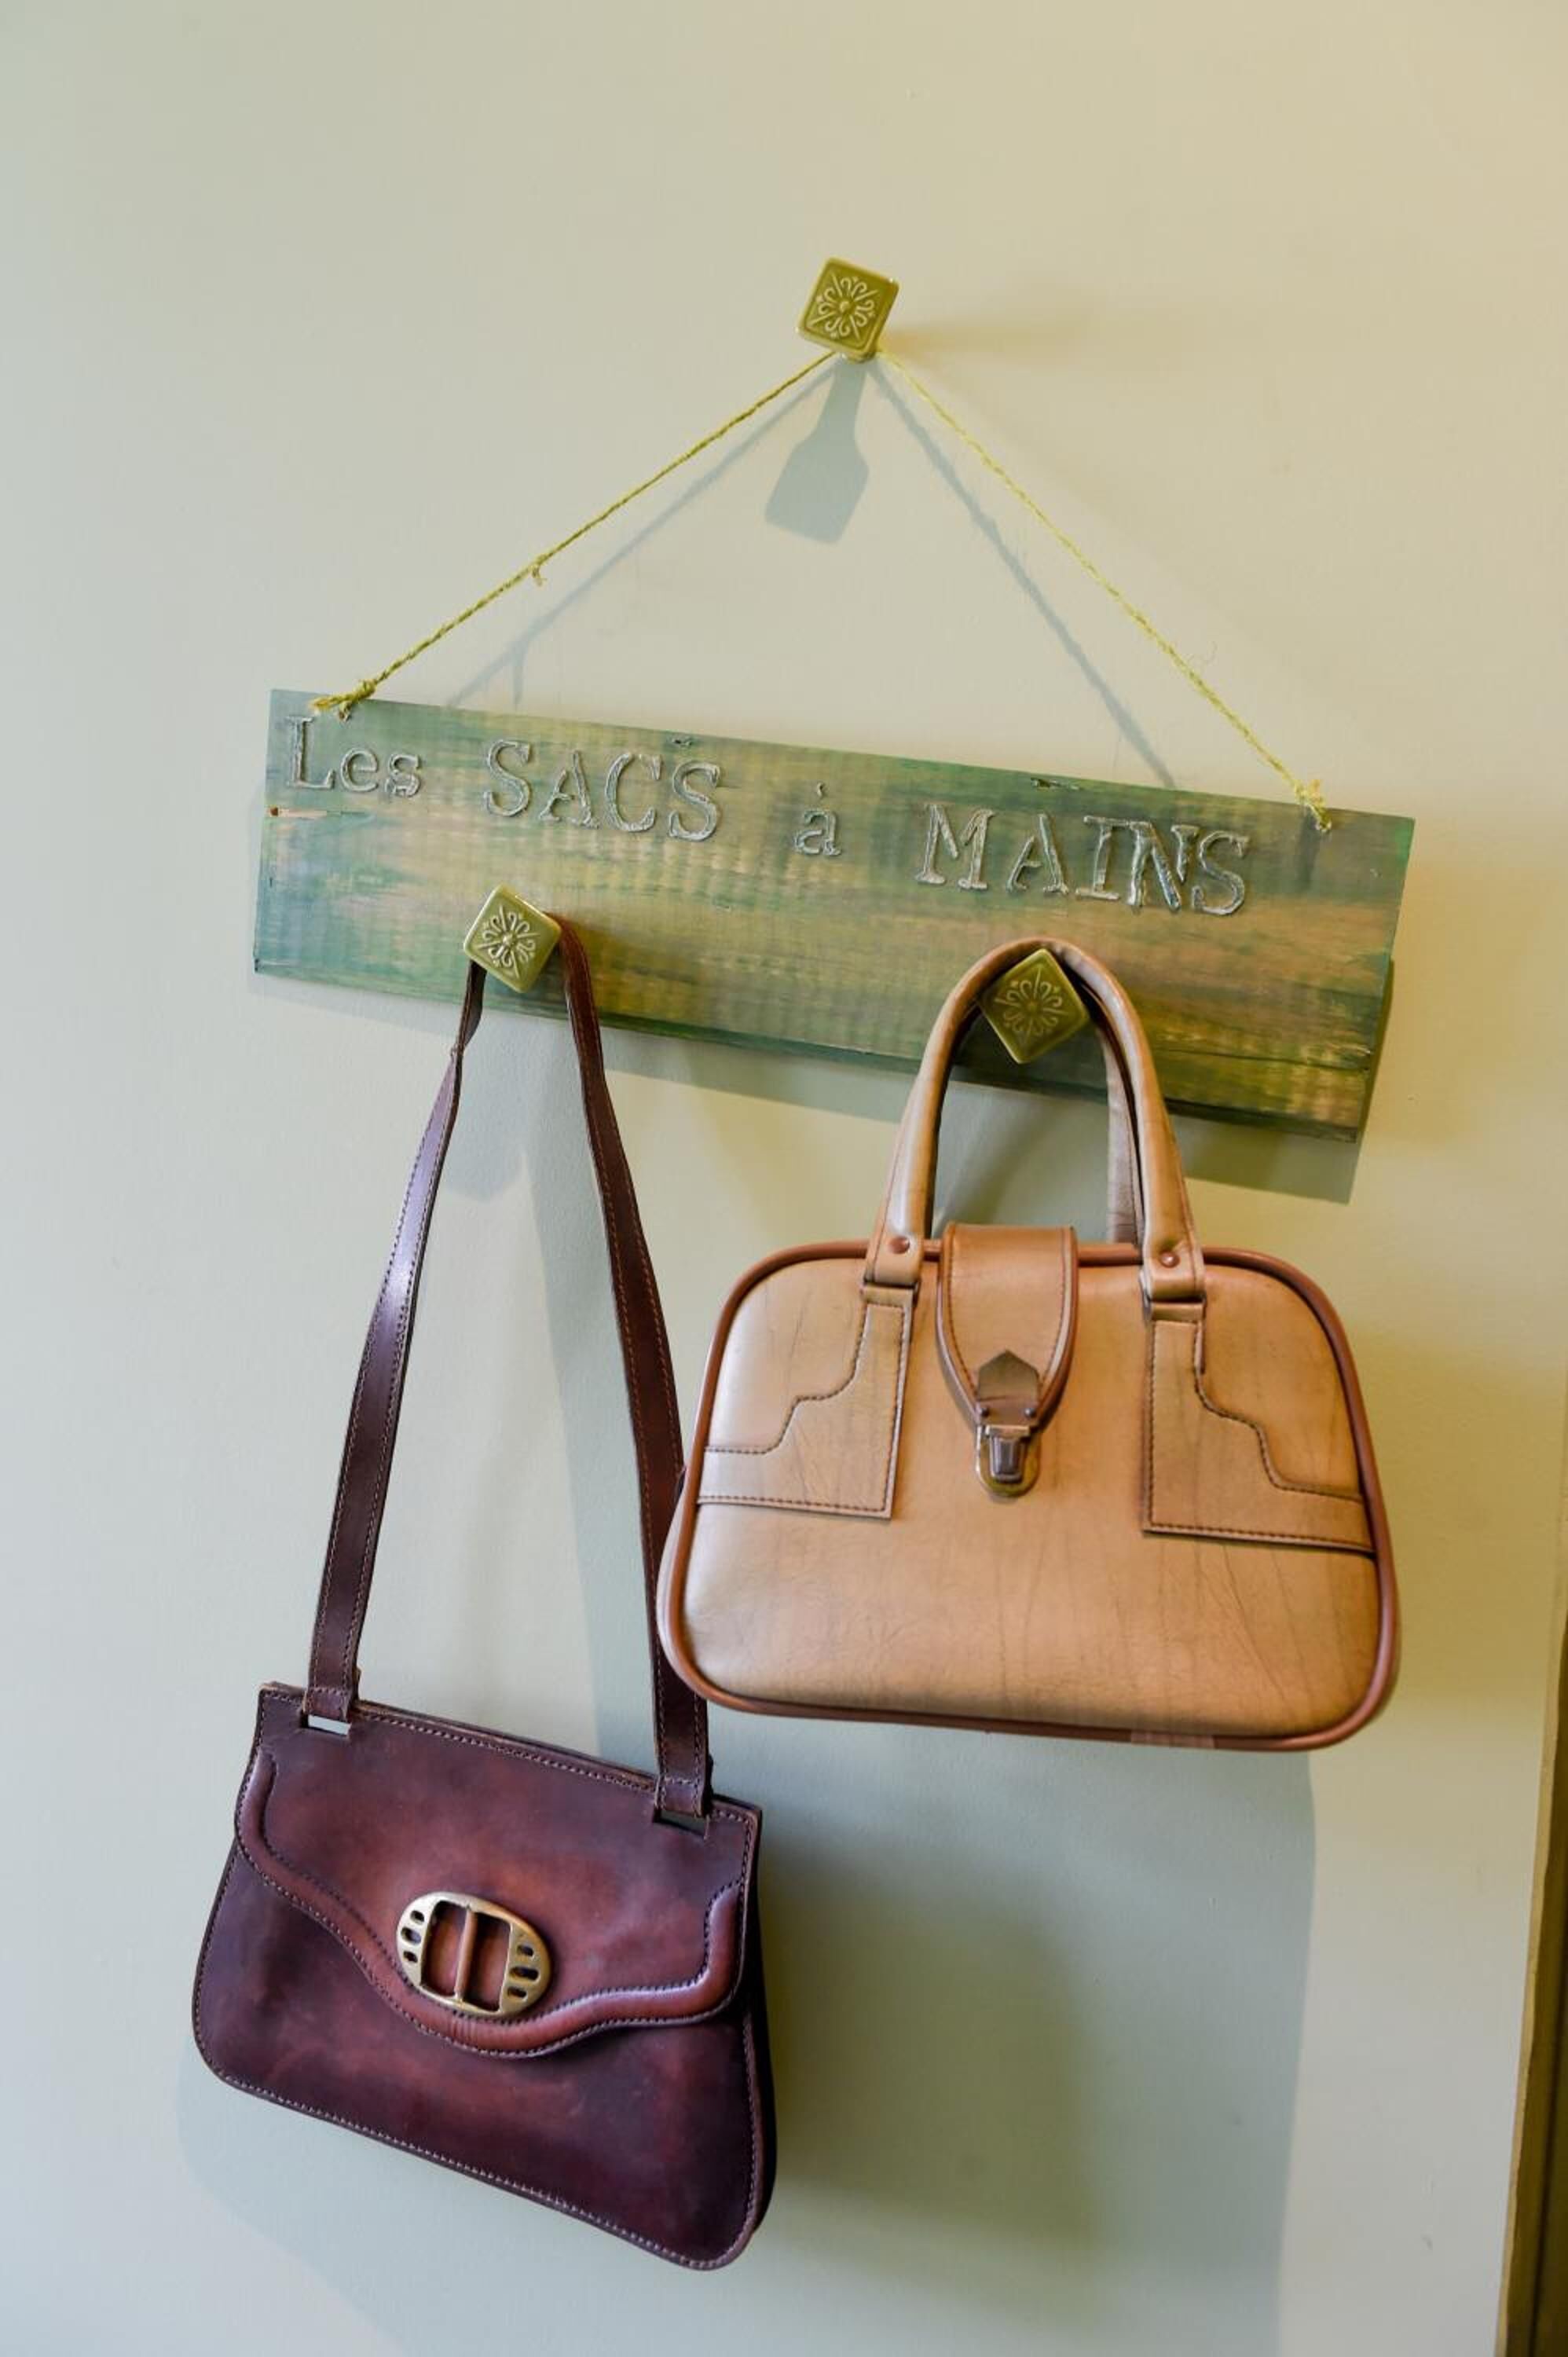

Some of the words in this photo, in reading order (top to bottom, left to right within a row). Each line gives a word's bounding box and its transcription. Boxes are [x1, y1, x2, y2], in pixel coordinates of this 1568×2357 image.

[284, 715, 423, 799] Les
[482, 739, 723, 842] SACS
[914, 802, 1251, 917] MAINS
